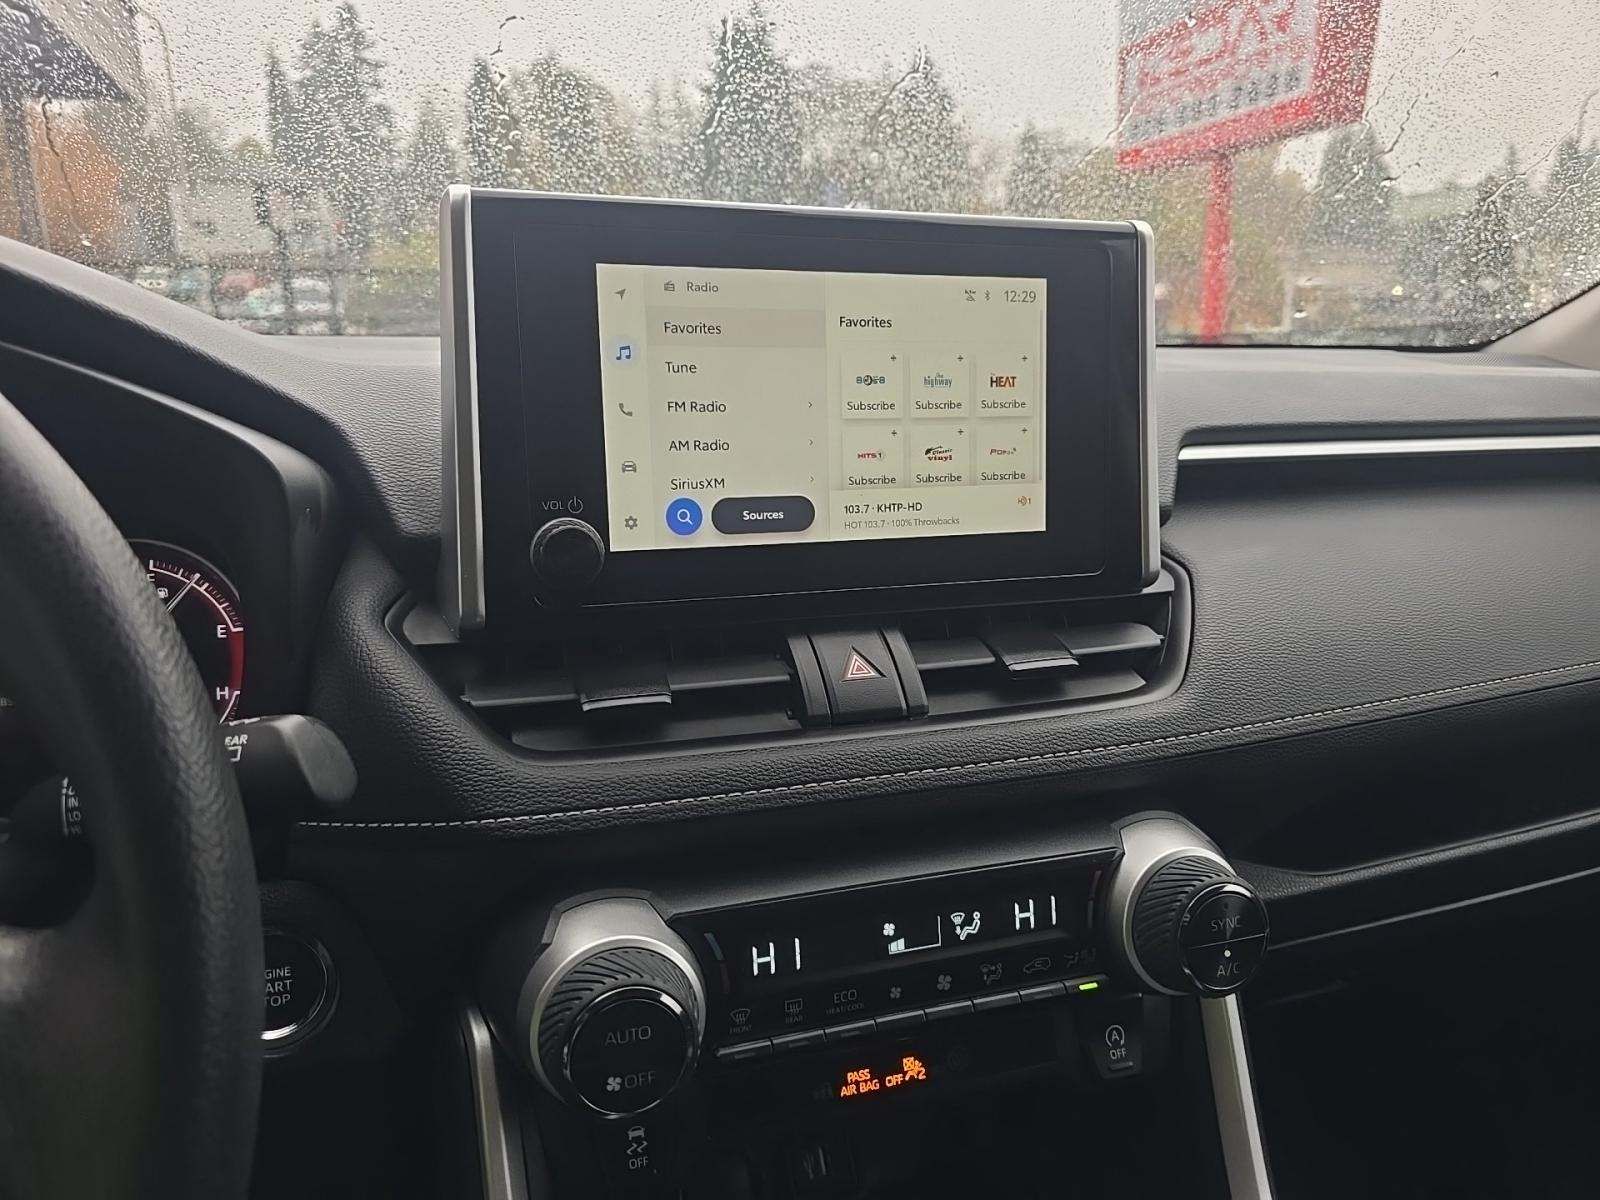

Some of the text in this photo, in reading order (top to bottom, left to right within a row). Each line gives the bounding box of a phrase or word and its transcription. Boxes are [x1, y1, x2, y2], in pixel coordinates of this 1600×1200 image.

[686, 281, 719, 293] Radio
[1003, 290, 1037, 303] 12:29
[663, 321, 722, 335] Favorites
[839, 316, 893, 328] Favorites
[665, 361, 698, 374] Tune
[923, 375, 953, 388] highway
[989, 376, 1017, 388] HEAT
[667, 400, 727, 413] FM Radio
[847, 401, 896, 411] Subscribe
[915, 400, 962, 410] Subscribe
[981, 399, 1026, 410] Subscribe
[668, 439, 730, 451] AM Radio
[848, 475, 897, 486] Subscribe
[915, 473, 962, 484] Subscribe
[981, 471, 1026, 481] Subscribe
[670, 478, 725, 490] SiriusXM
[542, 500, 564, 510] VOL
[844, 502, 923, 514] 103.7 KHTP-HD
[742, 510, 784, 520] Sources
[844, 517, 960, 530] HOT 103.7 100% Throwbacks
[216, 625, 227, 638] E
[216, 686, 229, 700] H
[224, 734, 248, 746] EAR
[1014, 895, 1057, 931] HI
[1210, 915, 1241, 932] SYNC
[752, 937, 801, 976] HI
[264, 966, 292, 979] GINE
[1216, 962, 1240, 977] A/C
[265, 979, 293, 993] ART
[264, 994, 291, 1007] TOP
[833, 989, 858, 1004] ECO
[604, 1025, 651, 1046] AUTO
[1109, 1048, 1127, 1060] OFF
[624, 1070, 656, 1089] OFF
[847, 1068, 871, 1084] PASS
[840, 1084, 858, 1098] AIR
[859, 1079, 880, 1093] BAG
[885, 1073, 904, 1088] OFF
[628, 1156, 649, 1170] OFF
